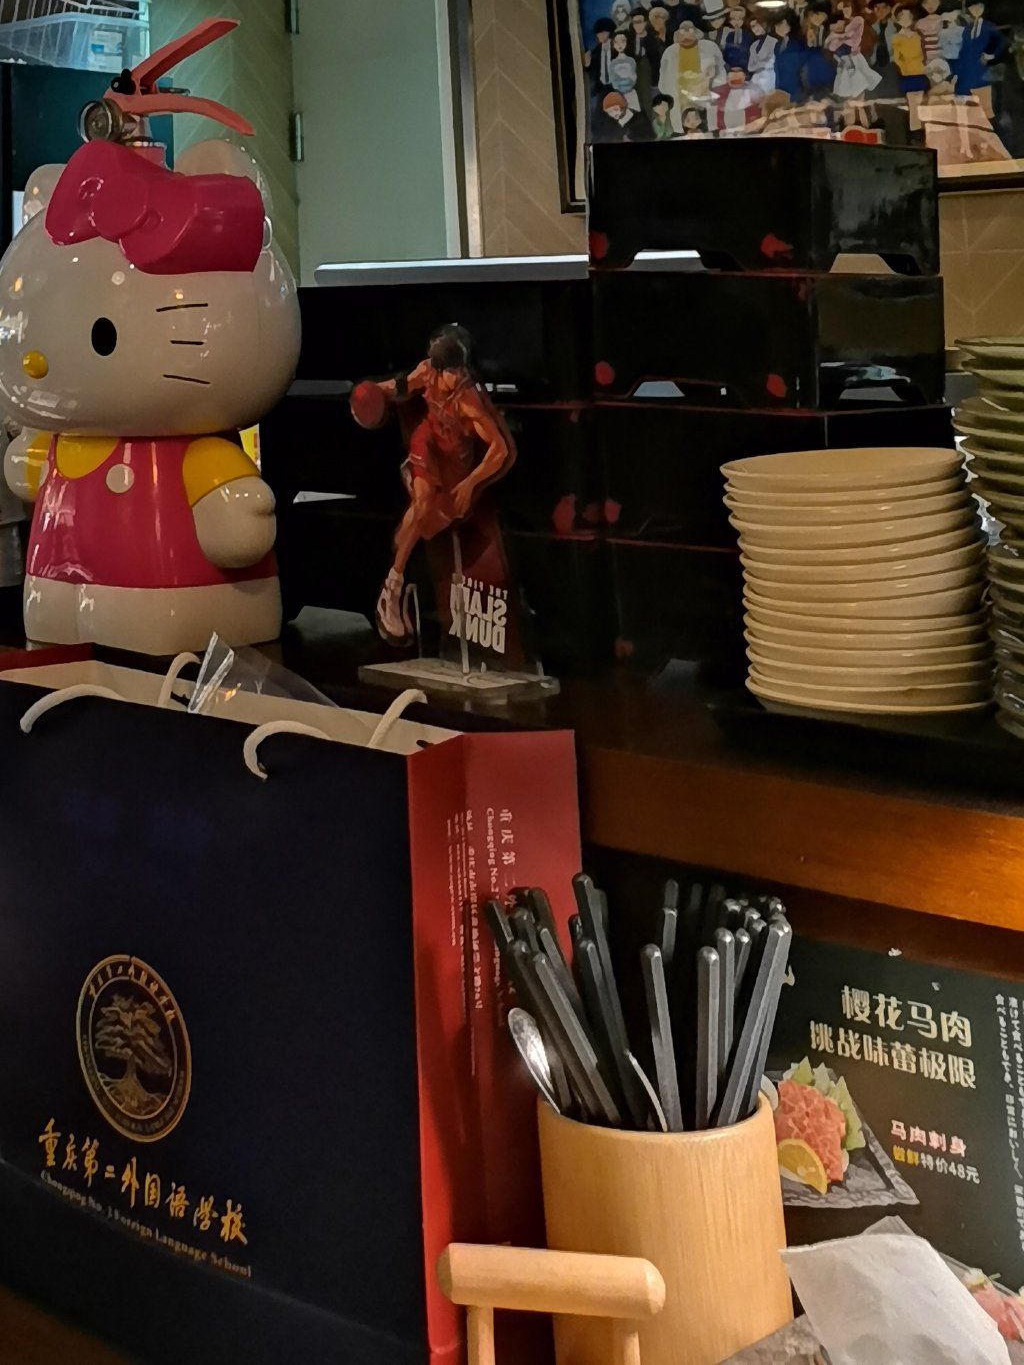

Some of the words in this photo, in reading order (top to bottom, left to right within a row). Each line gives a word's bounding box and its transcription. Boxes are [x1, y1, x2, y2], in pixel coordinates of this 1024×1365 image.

[841, 985, 972, 1048] 樱花马肉
[809, 1020, 977, 1090] 挑战味蕾极限
[890, 1119, 967, 1158] 马肉刺身
[155, 1227, 207, 1261] Language
